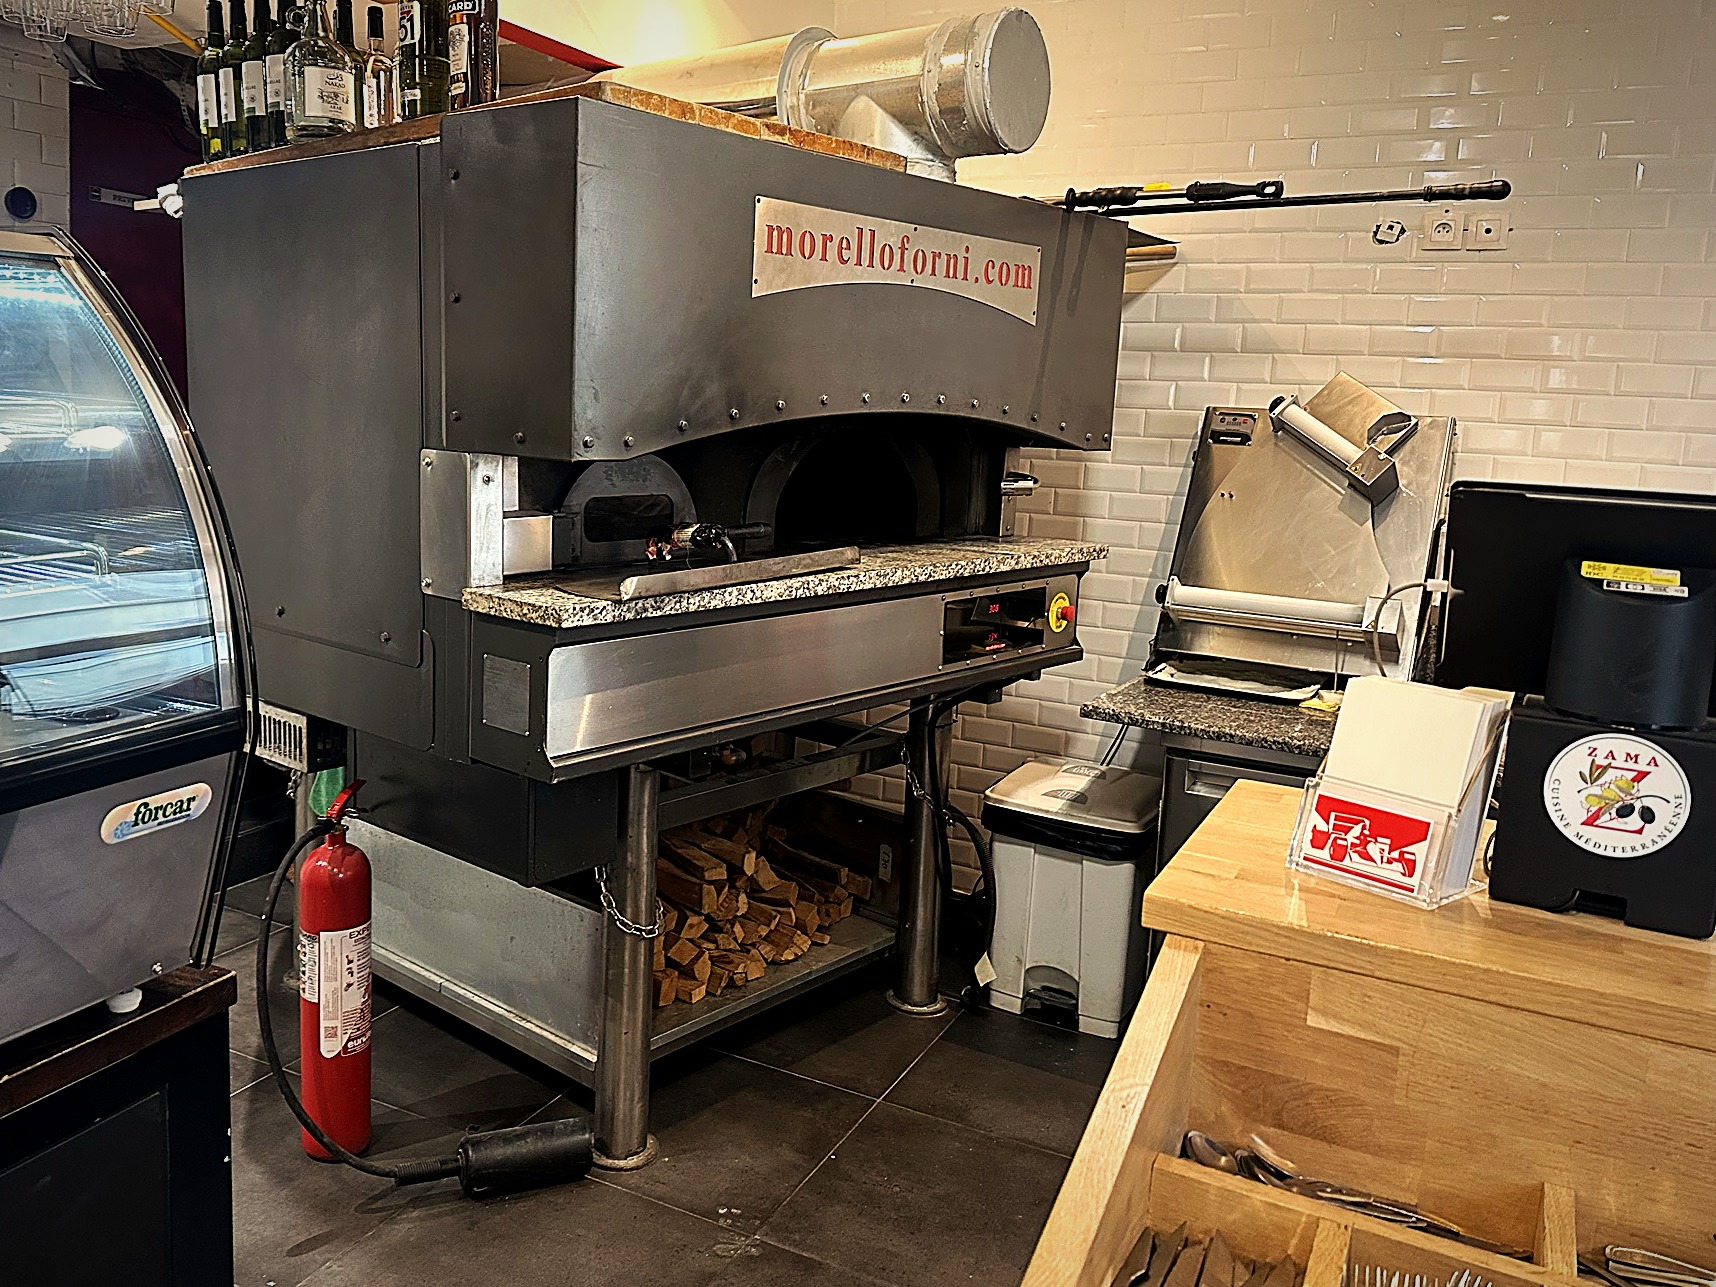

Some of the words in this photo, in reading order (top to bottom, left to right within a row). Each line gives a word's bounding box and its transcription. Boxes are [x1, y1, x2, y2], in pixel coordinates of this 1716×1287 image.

[399, 14, 415, 42] 51
[764, 223, 1033, 290] morelloforni.com
[1587, 746, 1660, 768] ZAMA
[131, 795, 196, 827] forcar
[1551, 778, 1572, 829] CUISINE
[1573, 793, 1684, 854] MÉDITERRANÉENNE
